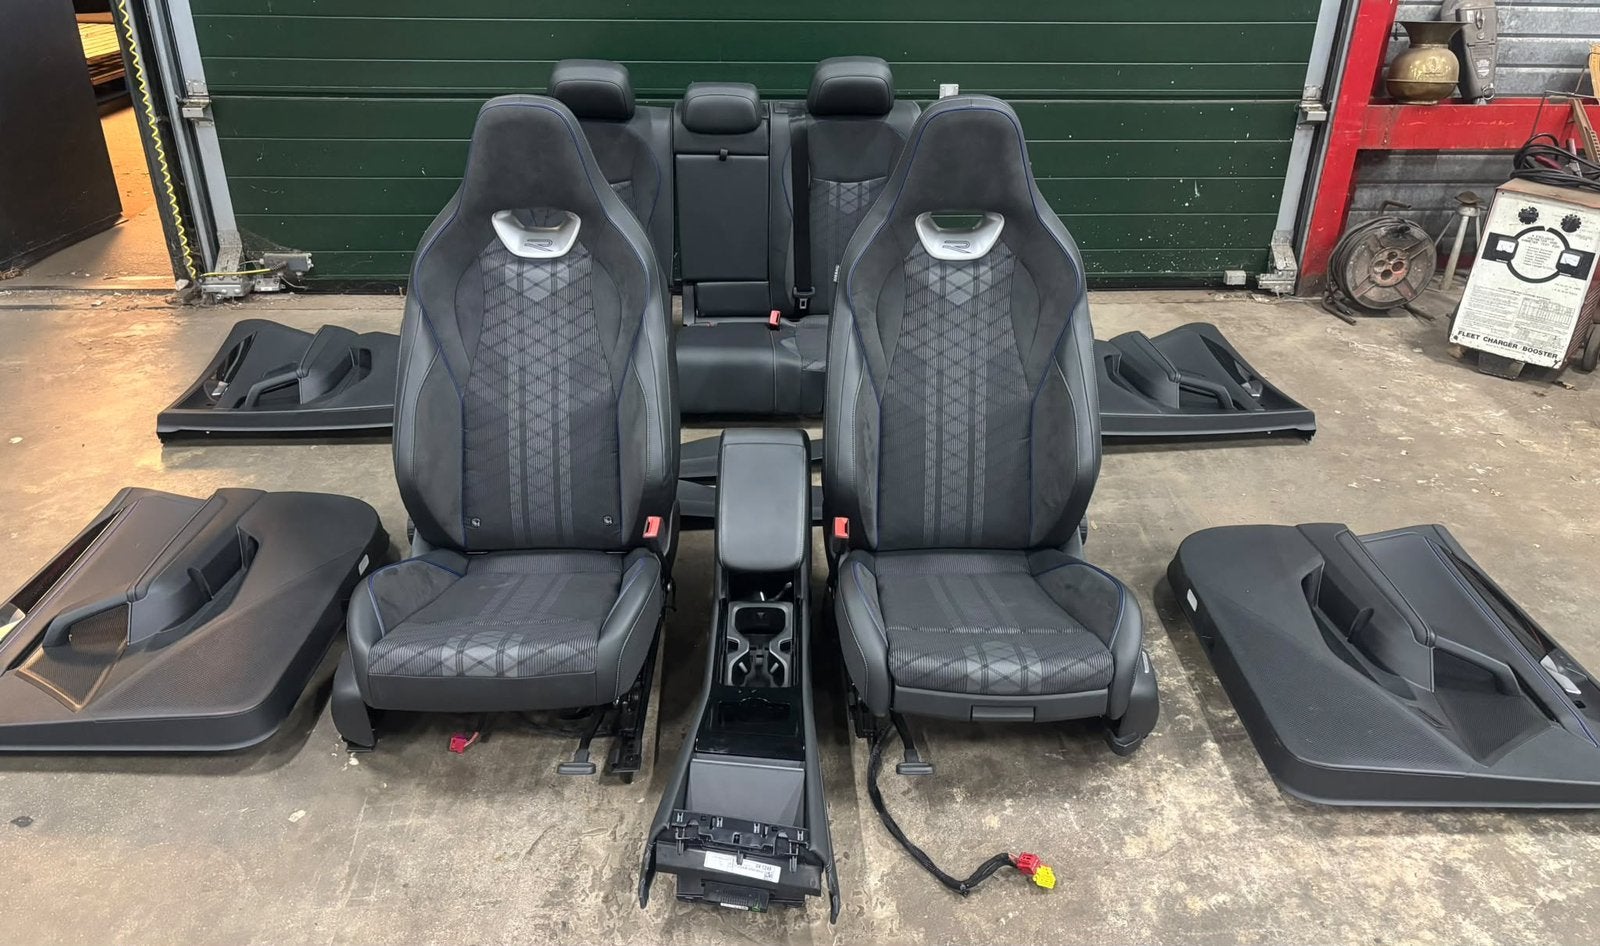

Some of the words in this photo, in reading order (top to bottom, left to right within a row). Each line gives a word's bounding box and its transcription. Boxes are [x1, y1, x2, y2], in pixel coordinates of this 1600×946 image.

[1458, 330, 1480, 340] FLEET
[1483, 336, 1518, 349] CHARGER
[1522, 346, 1558, 359] BOOSTER
